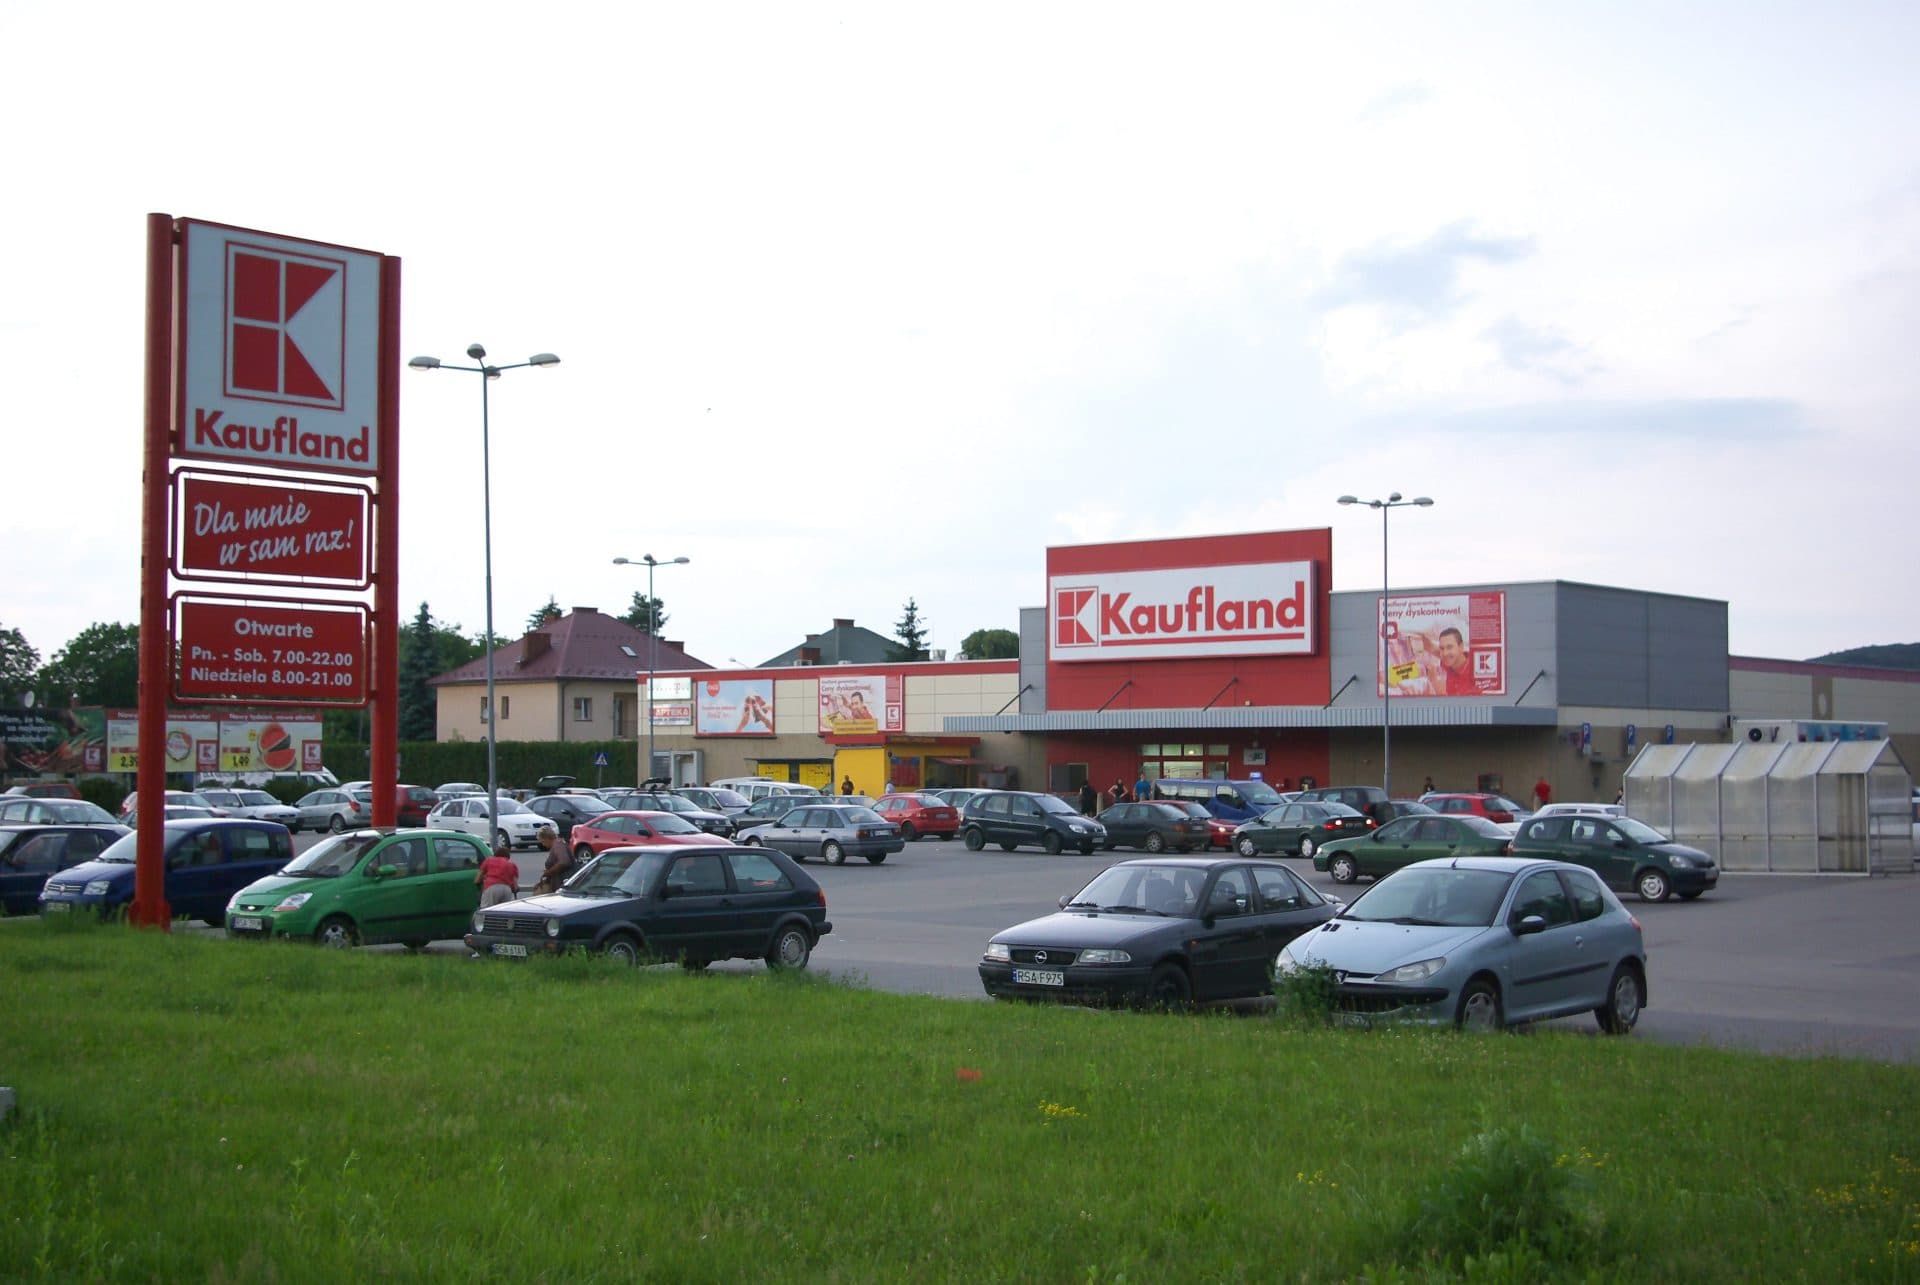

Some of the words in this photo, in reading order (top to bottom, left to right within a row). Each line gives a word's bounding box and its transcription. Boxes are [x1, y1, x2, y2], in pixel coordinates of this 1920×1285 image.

[194, 408, 369, 462] Kaufland
[194, 501, 239, 536] Dla
[245, 495, 311, 529] mnie
[219, 542, 245, 566] w
[249, 535, 300, 563] sam
[305, 519, 354, 554] raz!
[1101, 581, 1305, 635] Kaufland
[235, 618, 314, 638] Otwarte
[191, 646, 217, 661] Pn.
[234, 648, 267, 663] Sob.
[272, 650, 353, 666] 7.00-22.00
[191, 667, 267, 684] Niedziela
[272, 670, 353, 686] 8.00-21.00
[1017, 970, 1038, 983] RSA
[1039, 972, 1063, 985] F975
